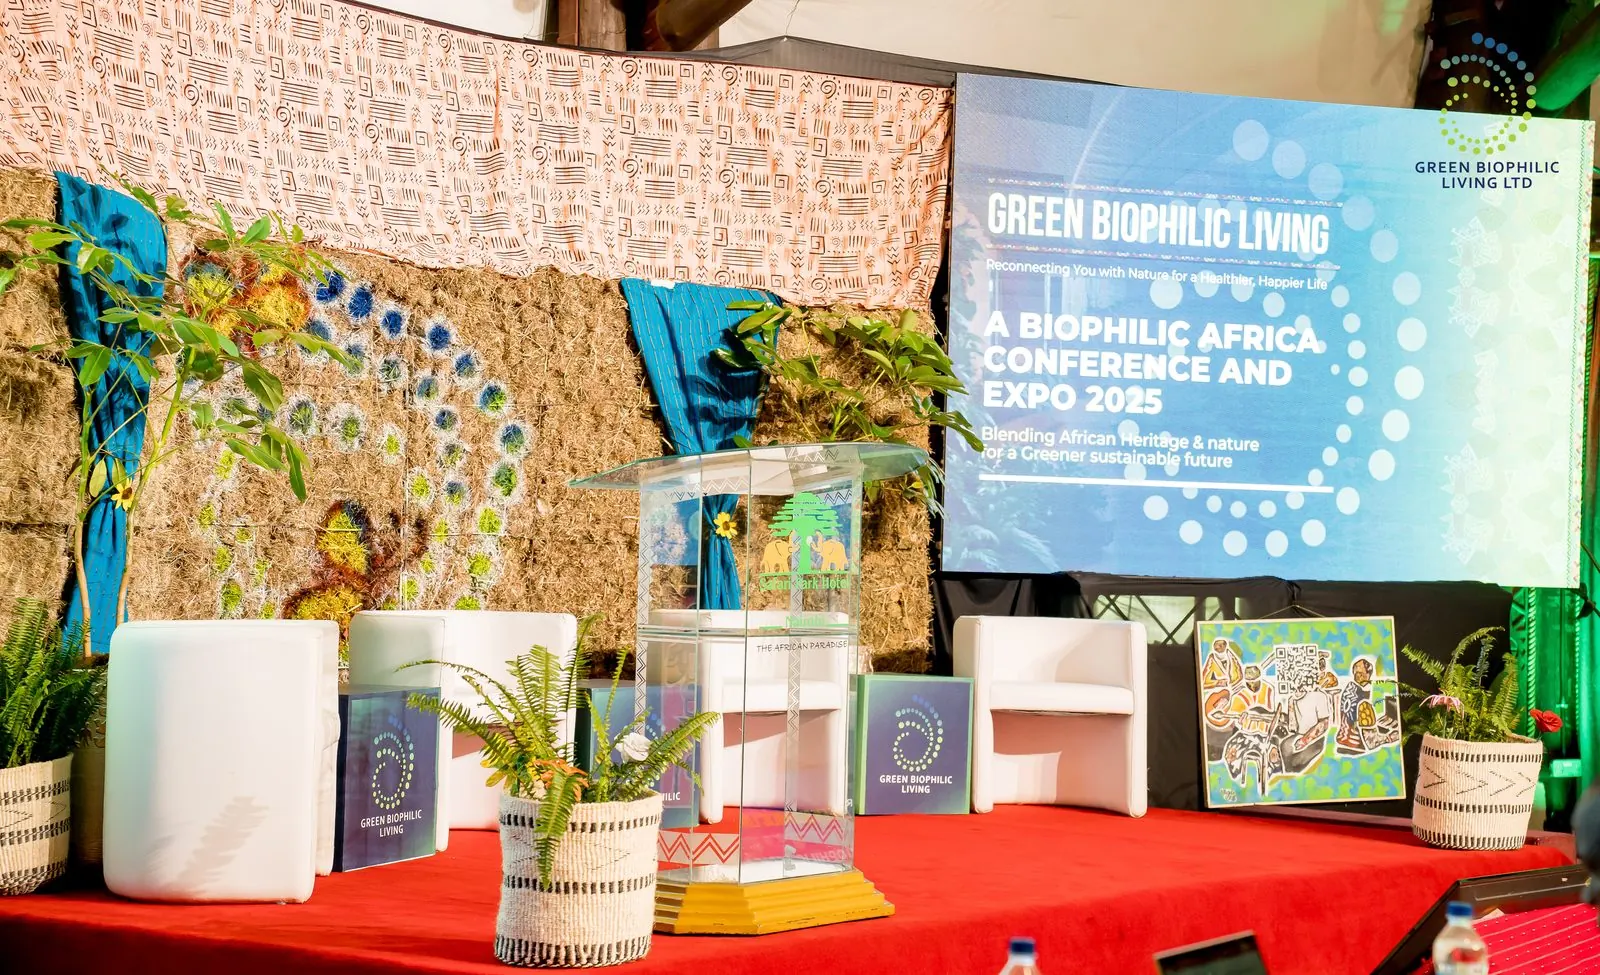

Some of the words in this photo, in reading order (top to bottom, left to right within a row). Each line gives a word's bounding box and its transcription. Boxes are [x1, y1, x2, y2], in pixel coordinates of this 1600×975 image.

[988, 192, 1084, 239] GREEN
[1091, 199, 1231, 249] BIOPHILIC
[1238, 208, 1330, 255] LIVING
[986, 258, 1071, 277] Reconnecting
[1073, 264, 1096, 277] You
[1100, 266, 1125, 278] with
[1128, 267, 1169, 281] Nature
[1171, 269, 1188, 282] for
[1190, 273, 1198, 283] a
[1200, 272, 1255, 287] Healthier,
[1258, 275, 1304, 290] Happier
[1307, 278, 1328, 290] Life
[983, 310, 1010, 338] A
[1019, 311, 1191, 347] BIOPHILIC
[1198, 322, 1321, 354] AFRICA
[983, 345, 1211, 383] CONFERENCE
[1218, 357, 1293, 386] AND
[983, 380, 1077, 411] EXPO
[1085, 385, 1163, 415] 2025
[981, 426, 1055, 446] Blending
[1059, 429, 1116, 446] African
[1121, 432, 1189, 451] Heritage
[1193, 435, 1204, 449] &
[1208, 437, 1260, 452] nature
[1007, 447, 1018, 460] a
[1021, 445, 1086, 463] Greener
[1090, 449, 1181, 467] sustainable
[1184, 451, 1233, 468] future
[822, 576, 849, 589] Hotel
[757, 645, 773, 653] THE
[774, 642, 808, 652] AFRICAN
[810, 640, 847, 650] PARADISE
[880, 774, 908, 784] GREEN
[910, 775, 953, 784] BIOPHILIC
[901, 785, 931, 794] LIVING
[360, 815, 386, 828] GREEN
[387, 809, 422, 824] BIOPHILIC
[380, 824, 404, 838] LIVING
